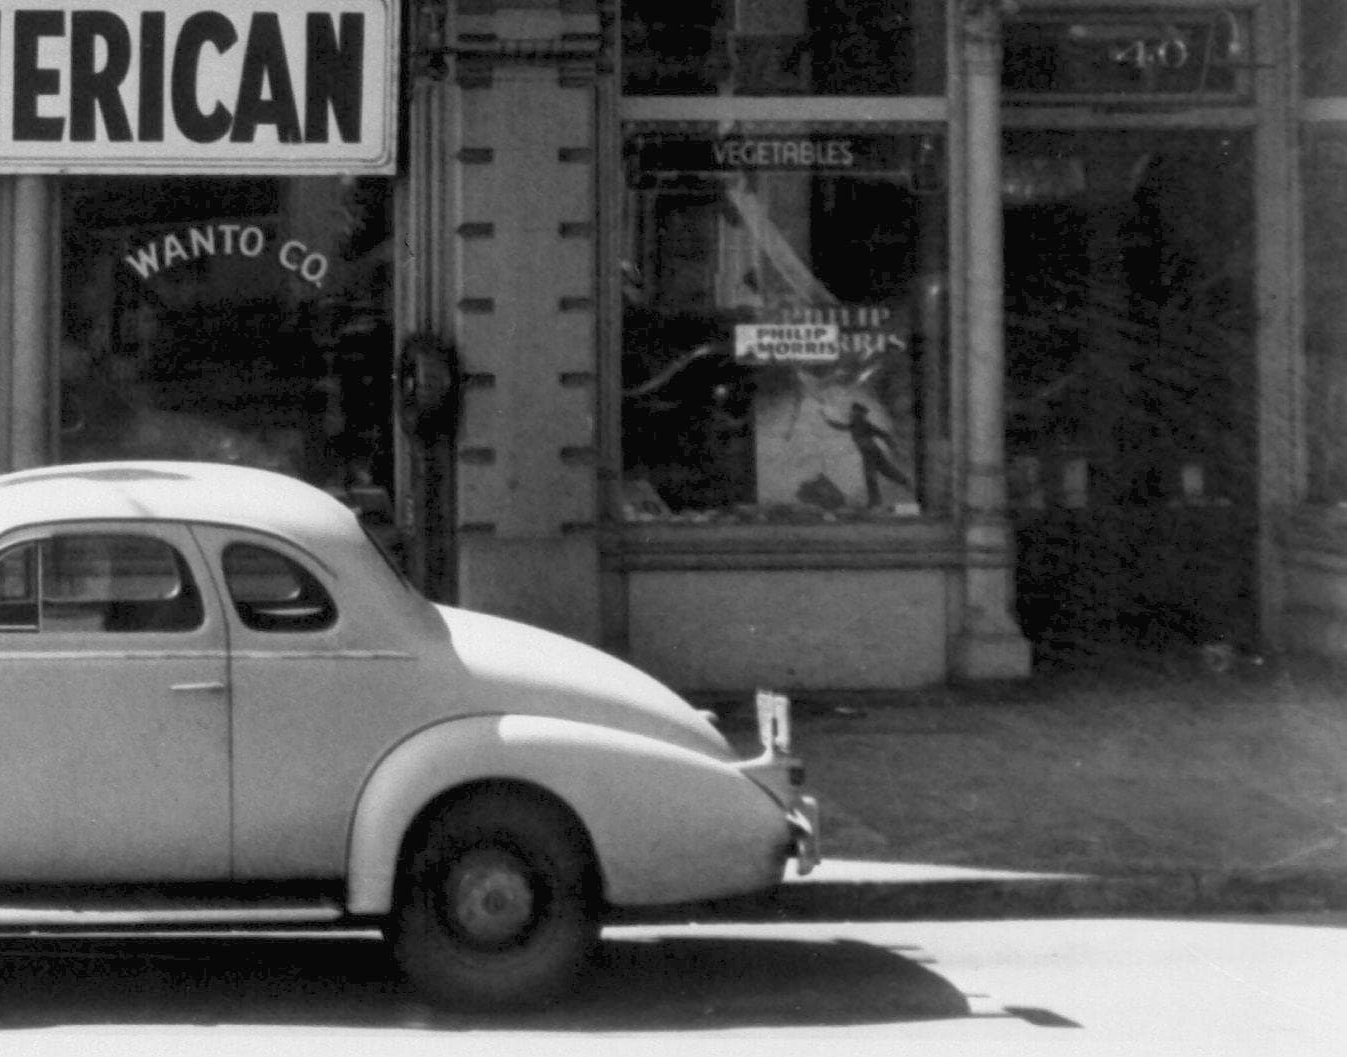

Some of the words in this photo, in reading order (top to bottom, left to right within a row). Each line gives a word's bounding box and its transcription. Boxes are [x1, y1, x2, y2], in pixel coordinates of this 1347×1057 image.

[712, 140, 854, 168] VEGETABLES
[124, 223, 265, 280] WANTO
[756, 328, 827, 341] PHILIP
[756, 340, 838, 356] MORRIS
